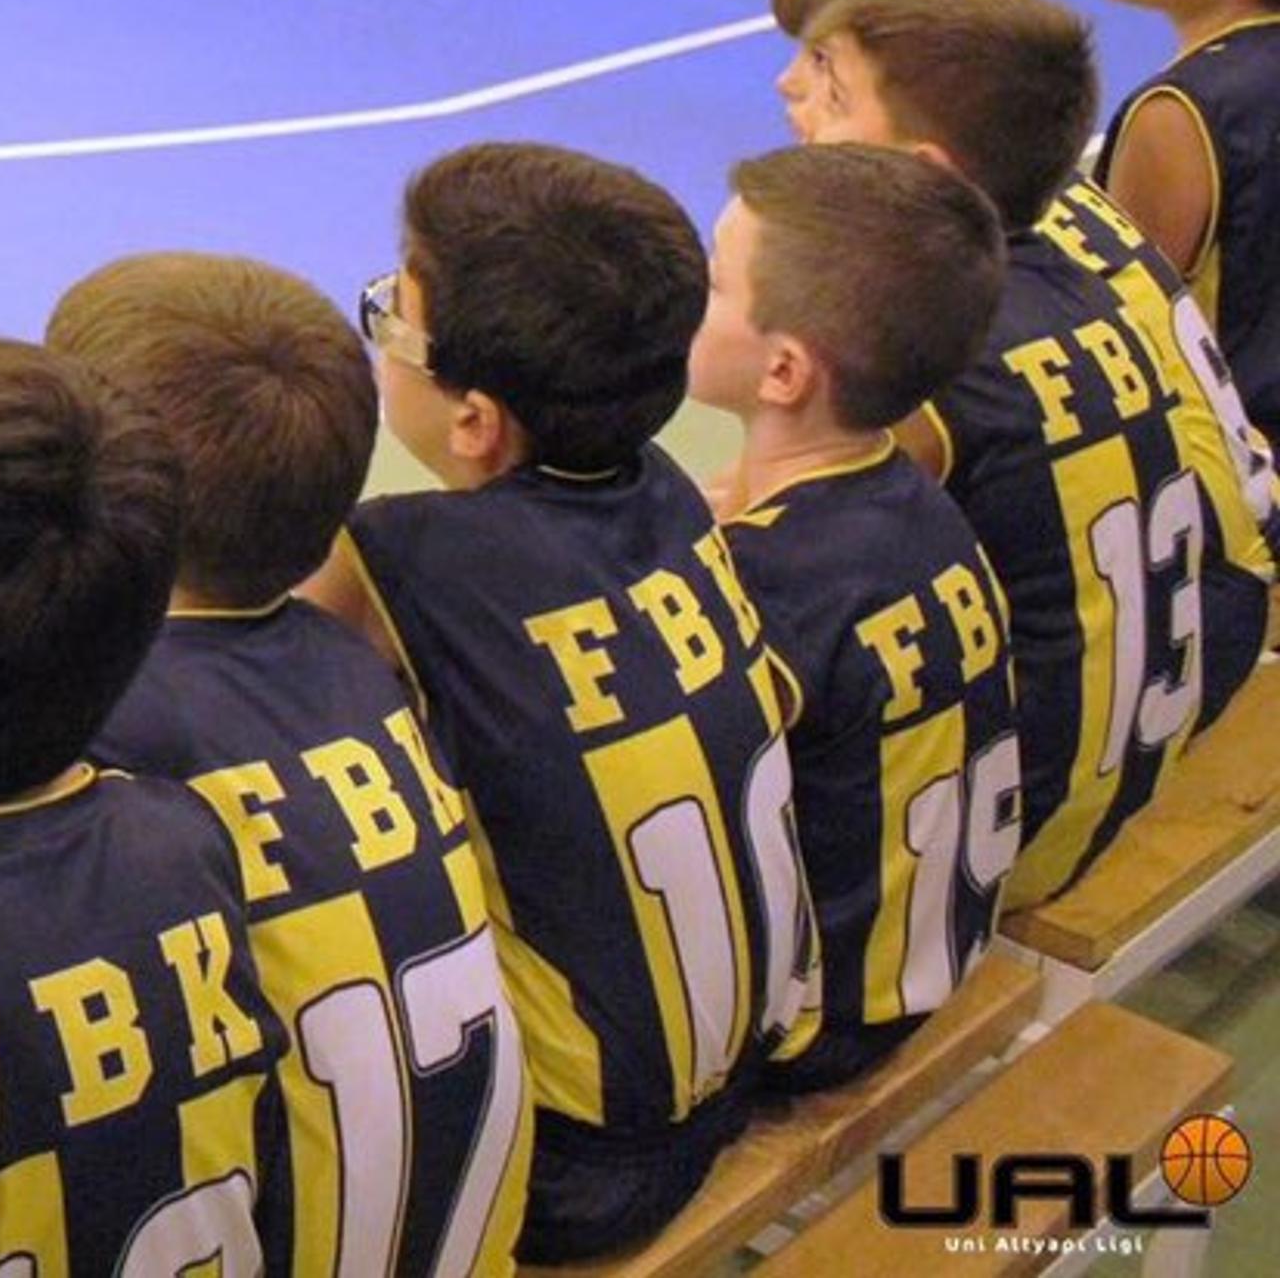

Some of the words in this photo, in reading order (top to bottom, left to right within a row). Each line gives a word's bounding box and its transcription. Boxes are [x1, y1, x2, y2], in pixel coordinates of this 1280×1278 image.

[856, 547, 1011, 722] FB
[28, 912, 263, 1127] BK
[296, 927, 531, 1278] 17
